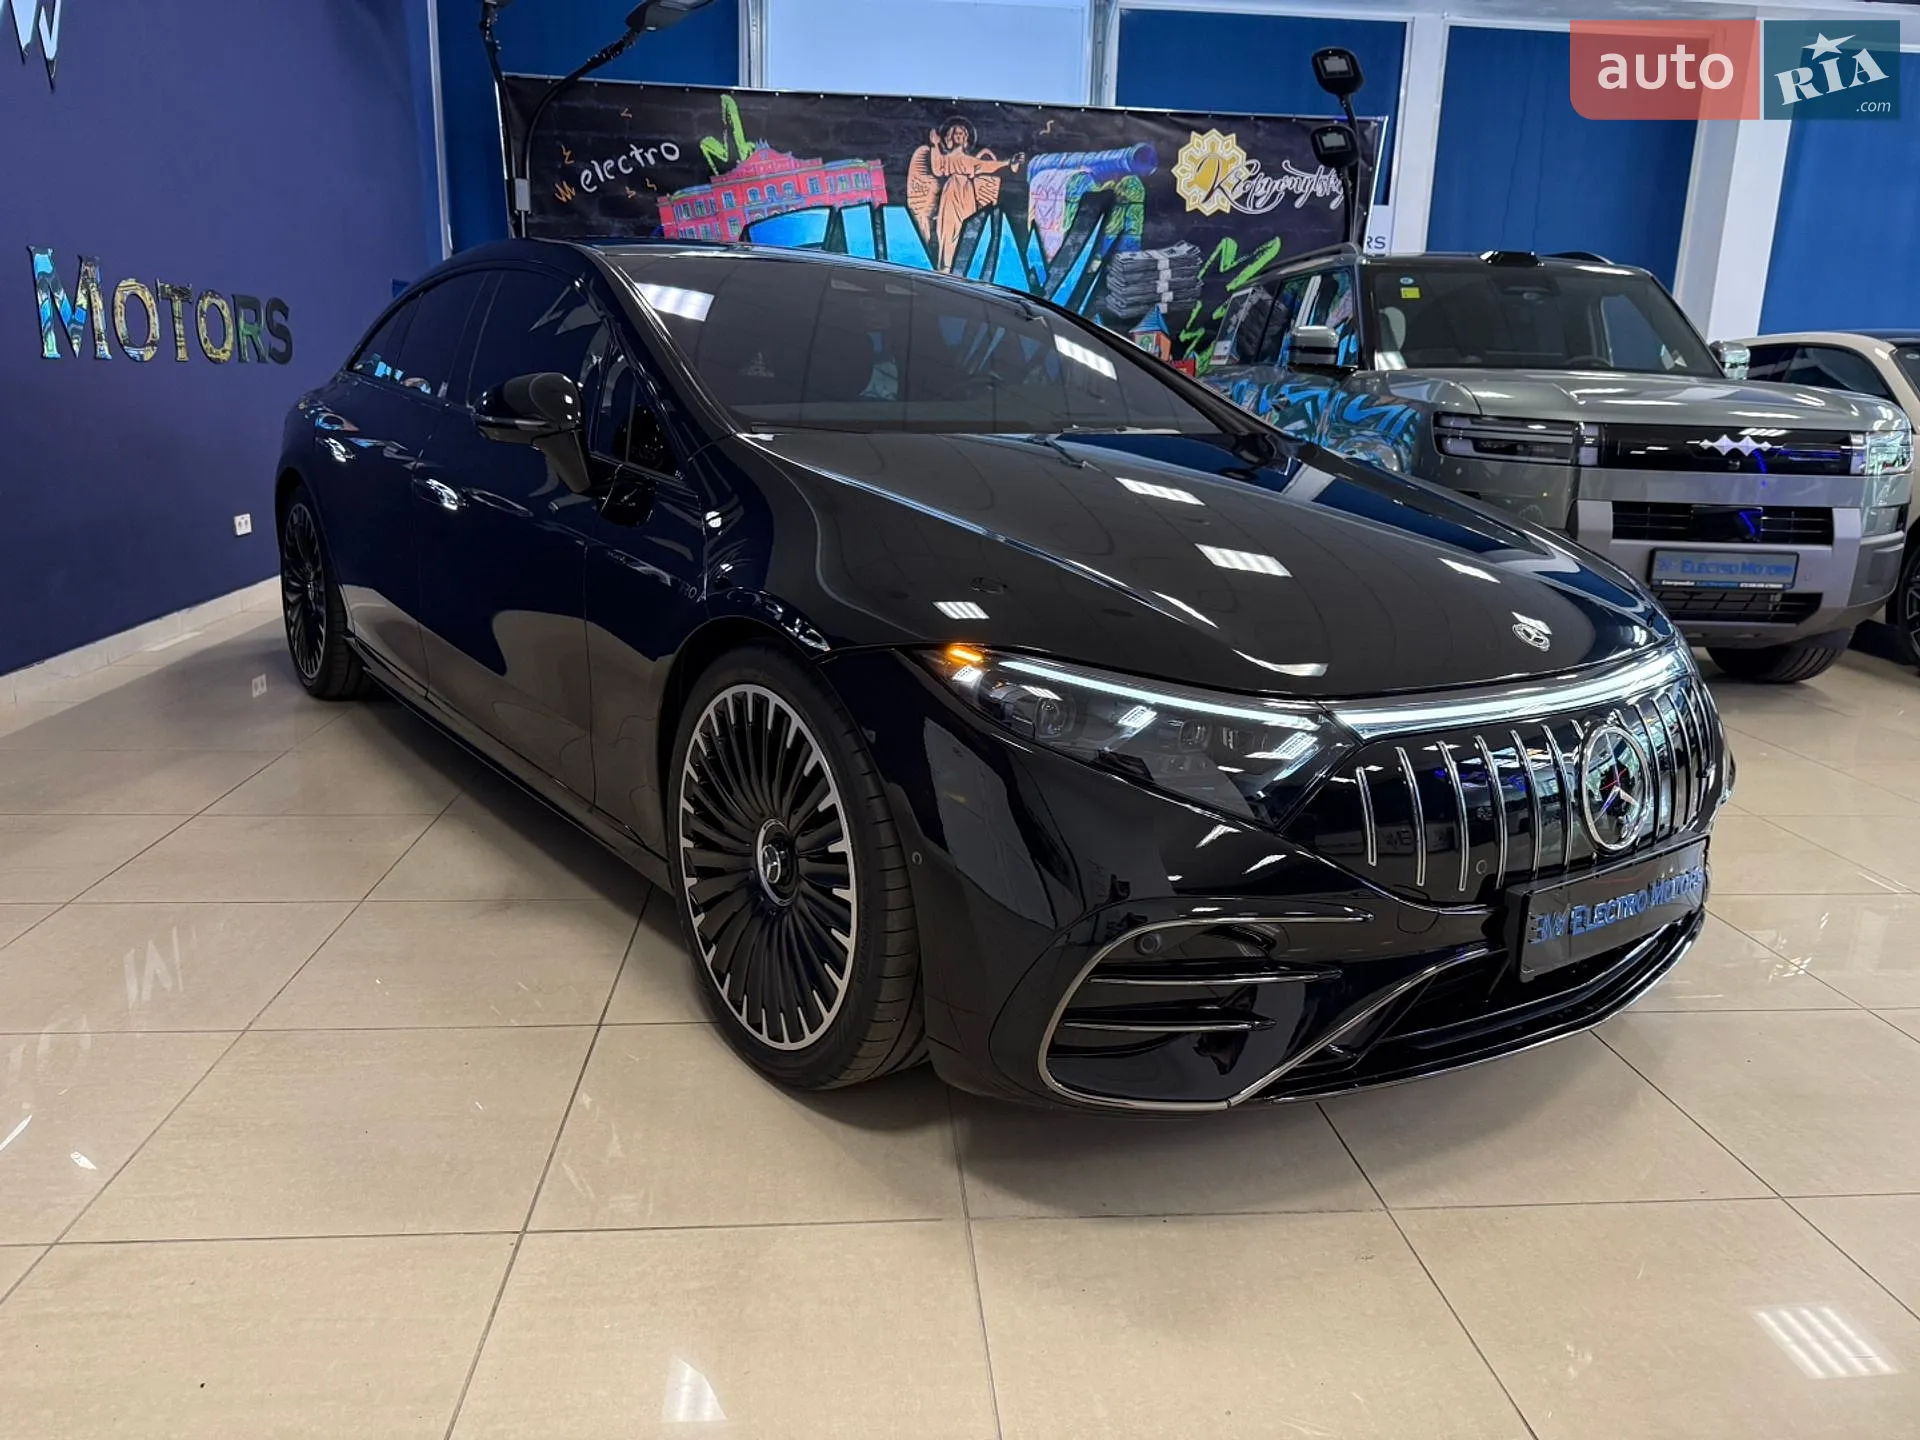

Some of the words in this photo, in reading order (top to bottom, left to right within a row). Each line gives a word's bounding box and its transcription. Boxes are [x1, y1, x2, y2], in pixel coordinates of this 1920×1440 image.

[580, 140, 680, 194] electro
[28, 244, 294, 365] MOTORS
[1571, 889, 1648, 936] ELECTRO
[1651, 866, 1704, 907] MOTORS
